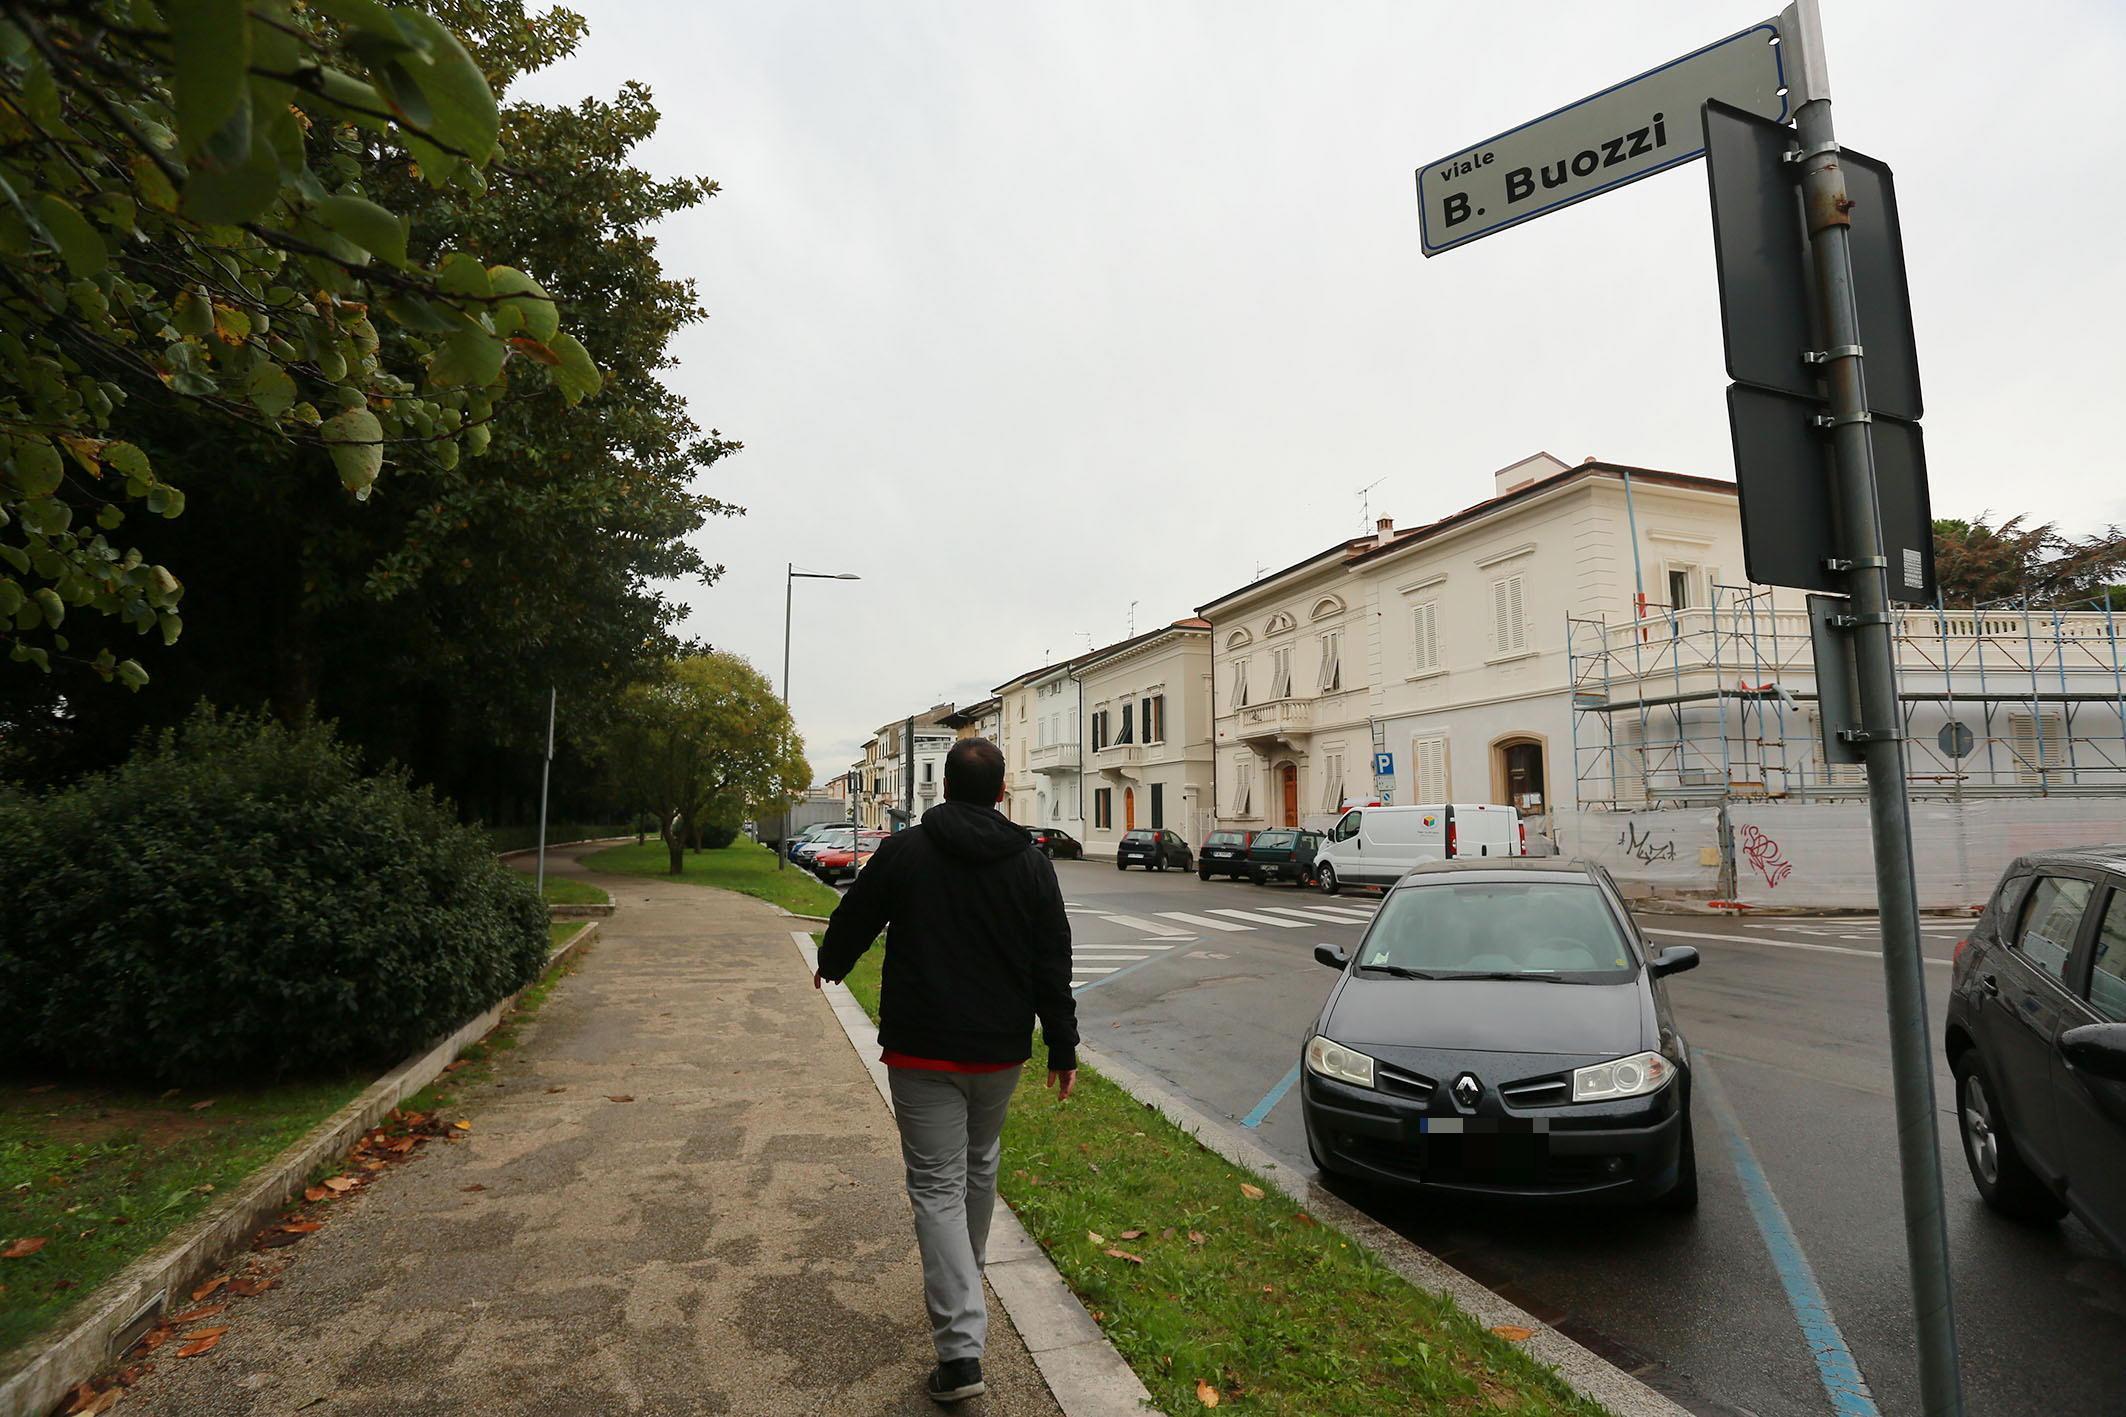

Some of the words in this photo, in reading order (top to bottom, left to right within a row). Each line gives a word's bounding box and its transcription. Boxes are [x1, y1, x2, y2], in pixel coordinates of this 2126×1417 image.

[1440, 152, 1495, 182] viale
[1443, 191, 1486, 228] B.
[1505, 112, 1667, 204] Buozzi
[1378, 755, 1391, 773] P
